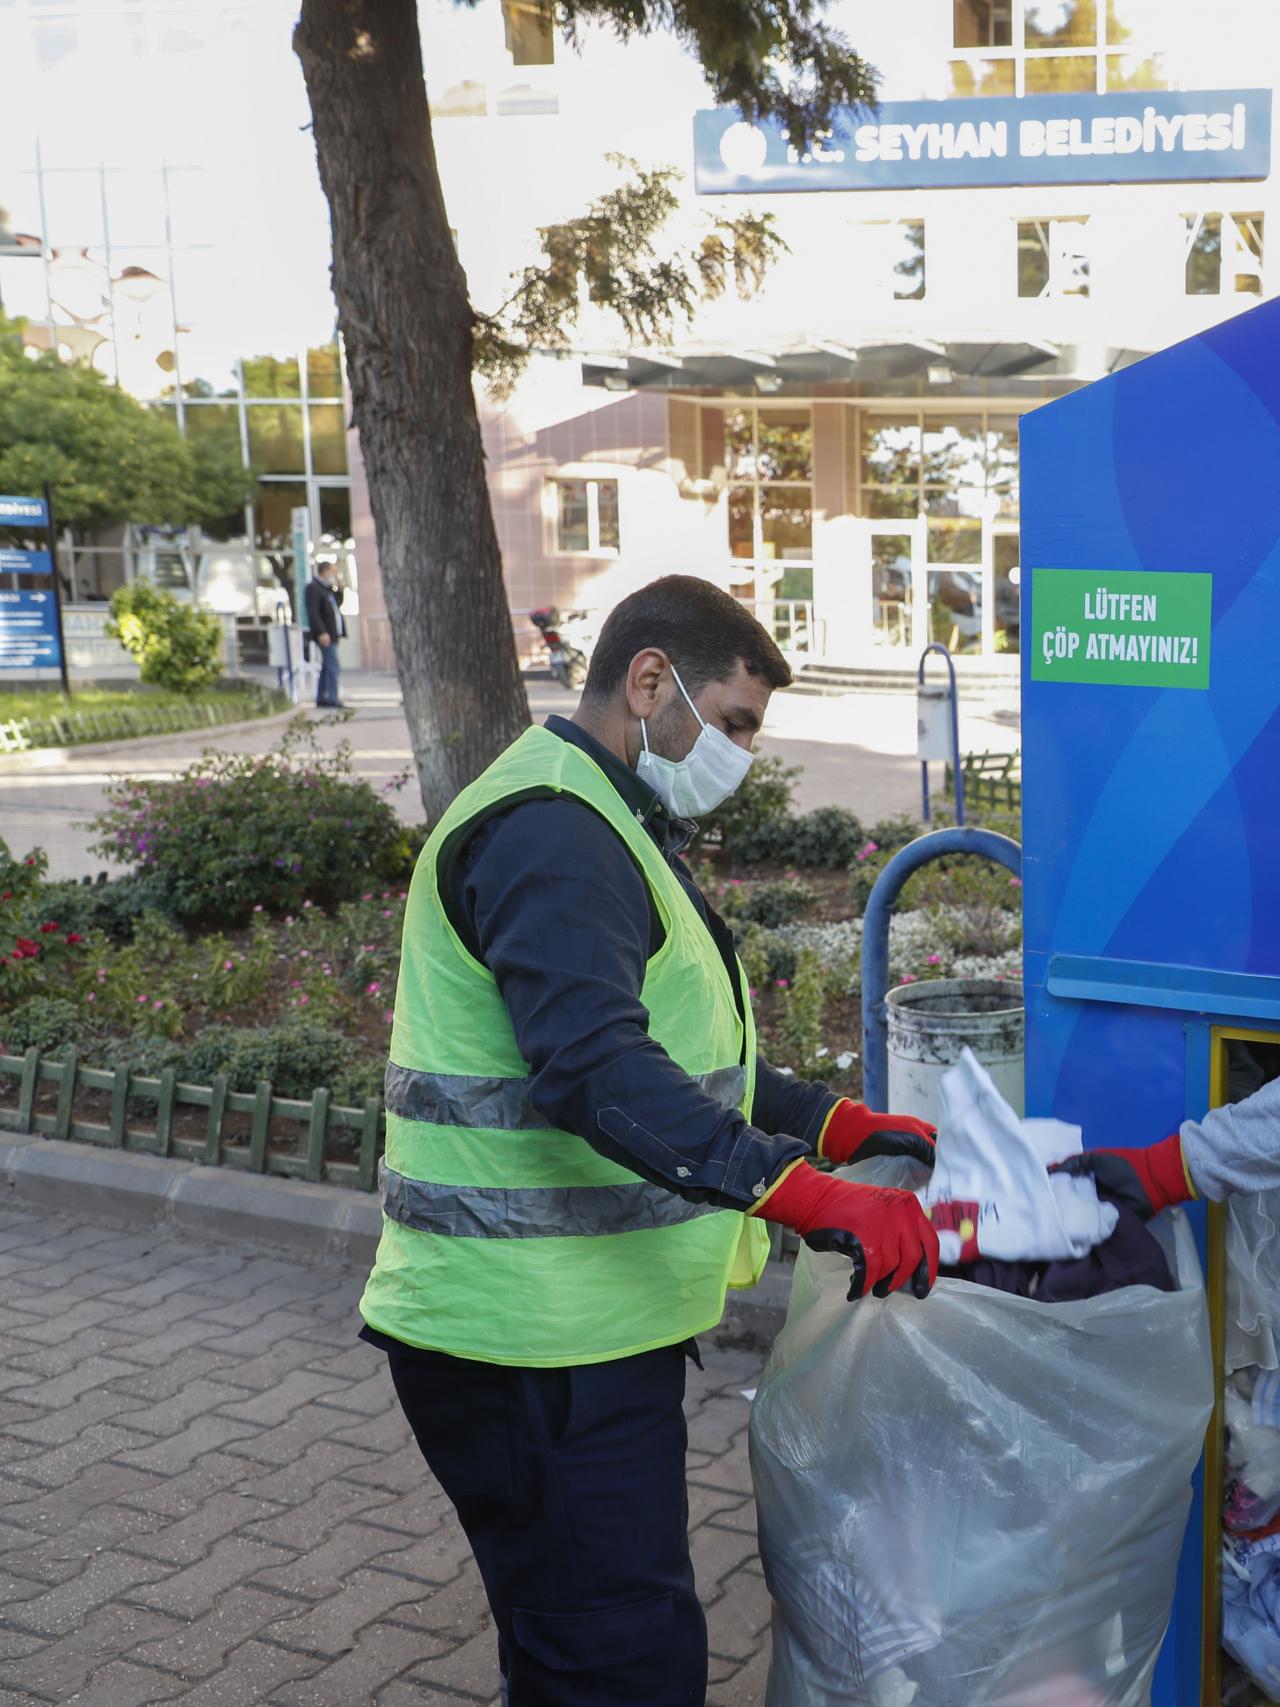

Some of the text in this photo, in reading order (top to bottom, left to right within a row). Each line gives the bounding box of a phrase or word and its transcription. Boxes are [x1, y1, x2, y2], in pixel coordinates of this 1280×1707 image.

[854, 121, 1007, 162] SEYHAN
[1019, 103, 1245, 157] BELEDİYESİ
[1084, 587, 1157, 622] LÜTFEN
[1042, 626, 1198, 664] ÇÖP ATMAYINIZ!
